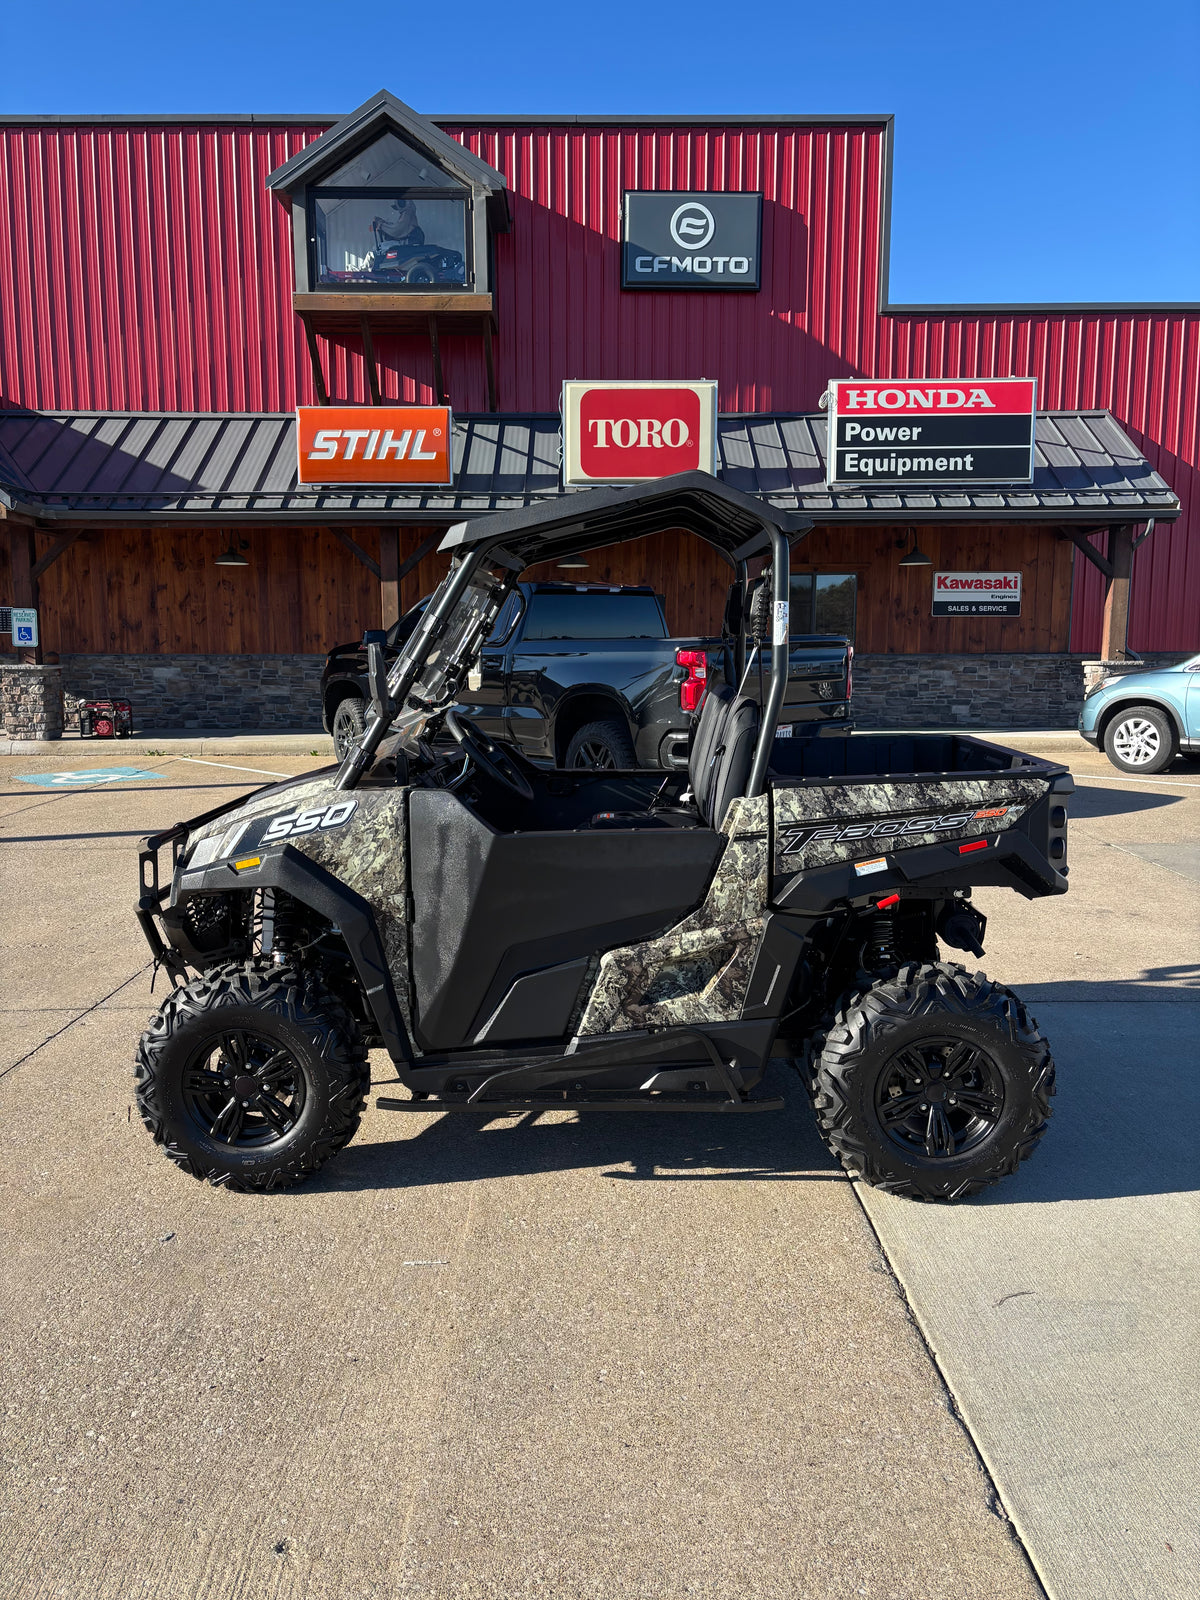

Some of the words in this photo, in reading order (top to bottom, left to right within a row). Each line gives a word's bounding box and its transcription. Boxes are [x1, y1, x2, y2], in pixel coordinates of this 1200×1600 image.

[635, 256, 749, 274] CFMOTO
[845, 388, 997, 409] HONDA
[845, 422, 922, 442] Power
[844, 453, 974, 476] Equipment
[937, 576, 1018, 590] Kawasaki
[259, 800, 359, 845] 550
[781, 811, 976, 855] T-BOSS
[973, 807, 1008, 819] 550
